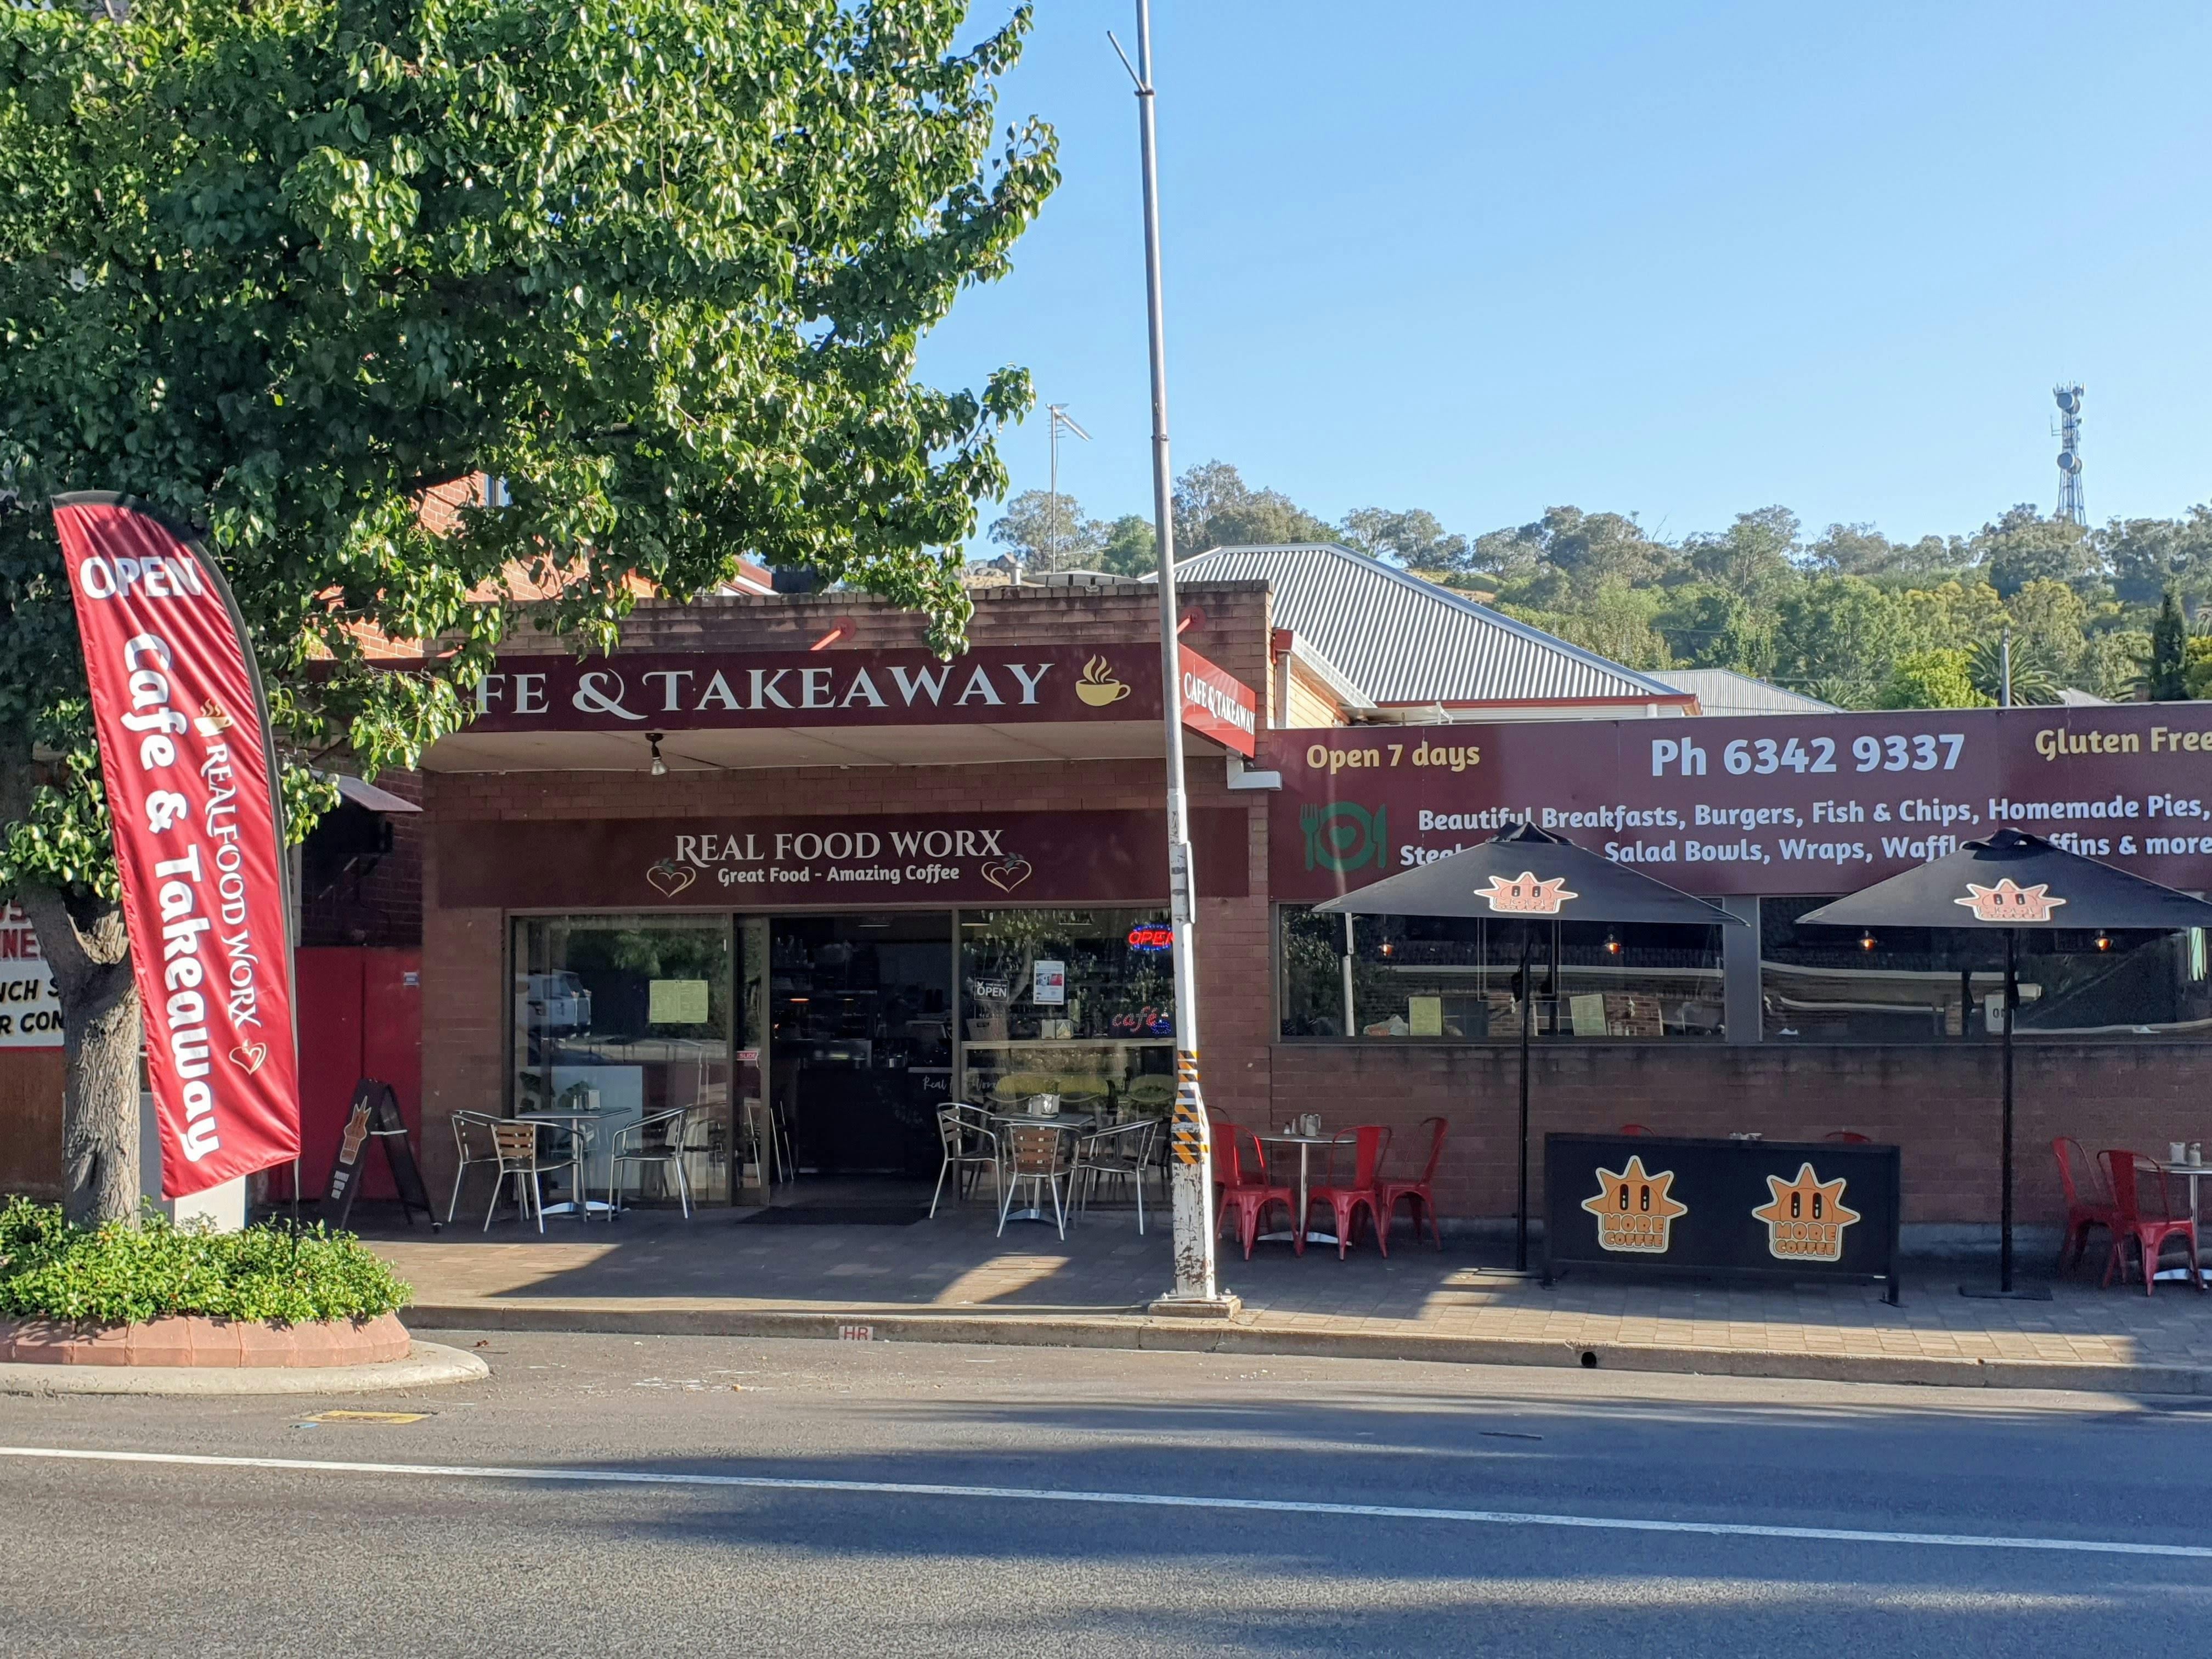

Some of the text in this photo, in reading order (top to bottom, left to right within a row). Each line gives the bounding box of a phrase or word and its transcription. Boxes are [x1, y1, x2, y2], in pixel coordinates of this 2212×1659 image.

[80, 556, 203, 599] OPEN
[454, 662, 1055, 720] FE & TAKEAWAY
[1184, 672, 1255, 735] CAFE & TAKEAWAY
[1306, 741, 1481, 775] Open 7 days
[1651, 733, 1965, 777] Ph 6342 9337
[2035, 726, 2212, 761] Gluten Free
[1419, 793, 2211, 832] Beautiful Breakfasts, Burgers, Fish & Chips, Homemade Pies,
[675, 829, 1006, 868] REAL FOOD WORX
[1400, 843, 1463, 866] Stea
[1604, 839, 1677, 864] Salad
[1685, 838, 1771, 865] Bowls,
[1779, 838, 1874, 865] Wraps,
[1881, 834, 1973, 862] Waffl
[2118, 835, 2137, 855] &
[2145, 836, 2212, 855] more
[200, 742, 263, 1029] REAL FOOD WORX
[718, 867, 765, 887] Great
[769, 866, 810, 883] Food
[826, 865, 901, 885] Amazing
[905, 864, 960, 884] Coffee
[121, 633, 220, 1163] Cafe & Takeaway
[1128, 932, 1175, 945] OPEN
[977, 986, 1007, 997] OPEN
[1603, 1214, 1666, 1234] MORE
[1603, 1233, 1663, 1248] COFFEE
[1774, 1222, 1837, 1242] MORE
[1775, 1239, 1836, 1256] COFFEE
[844, 1326, 868, 1340] HR
